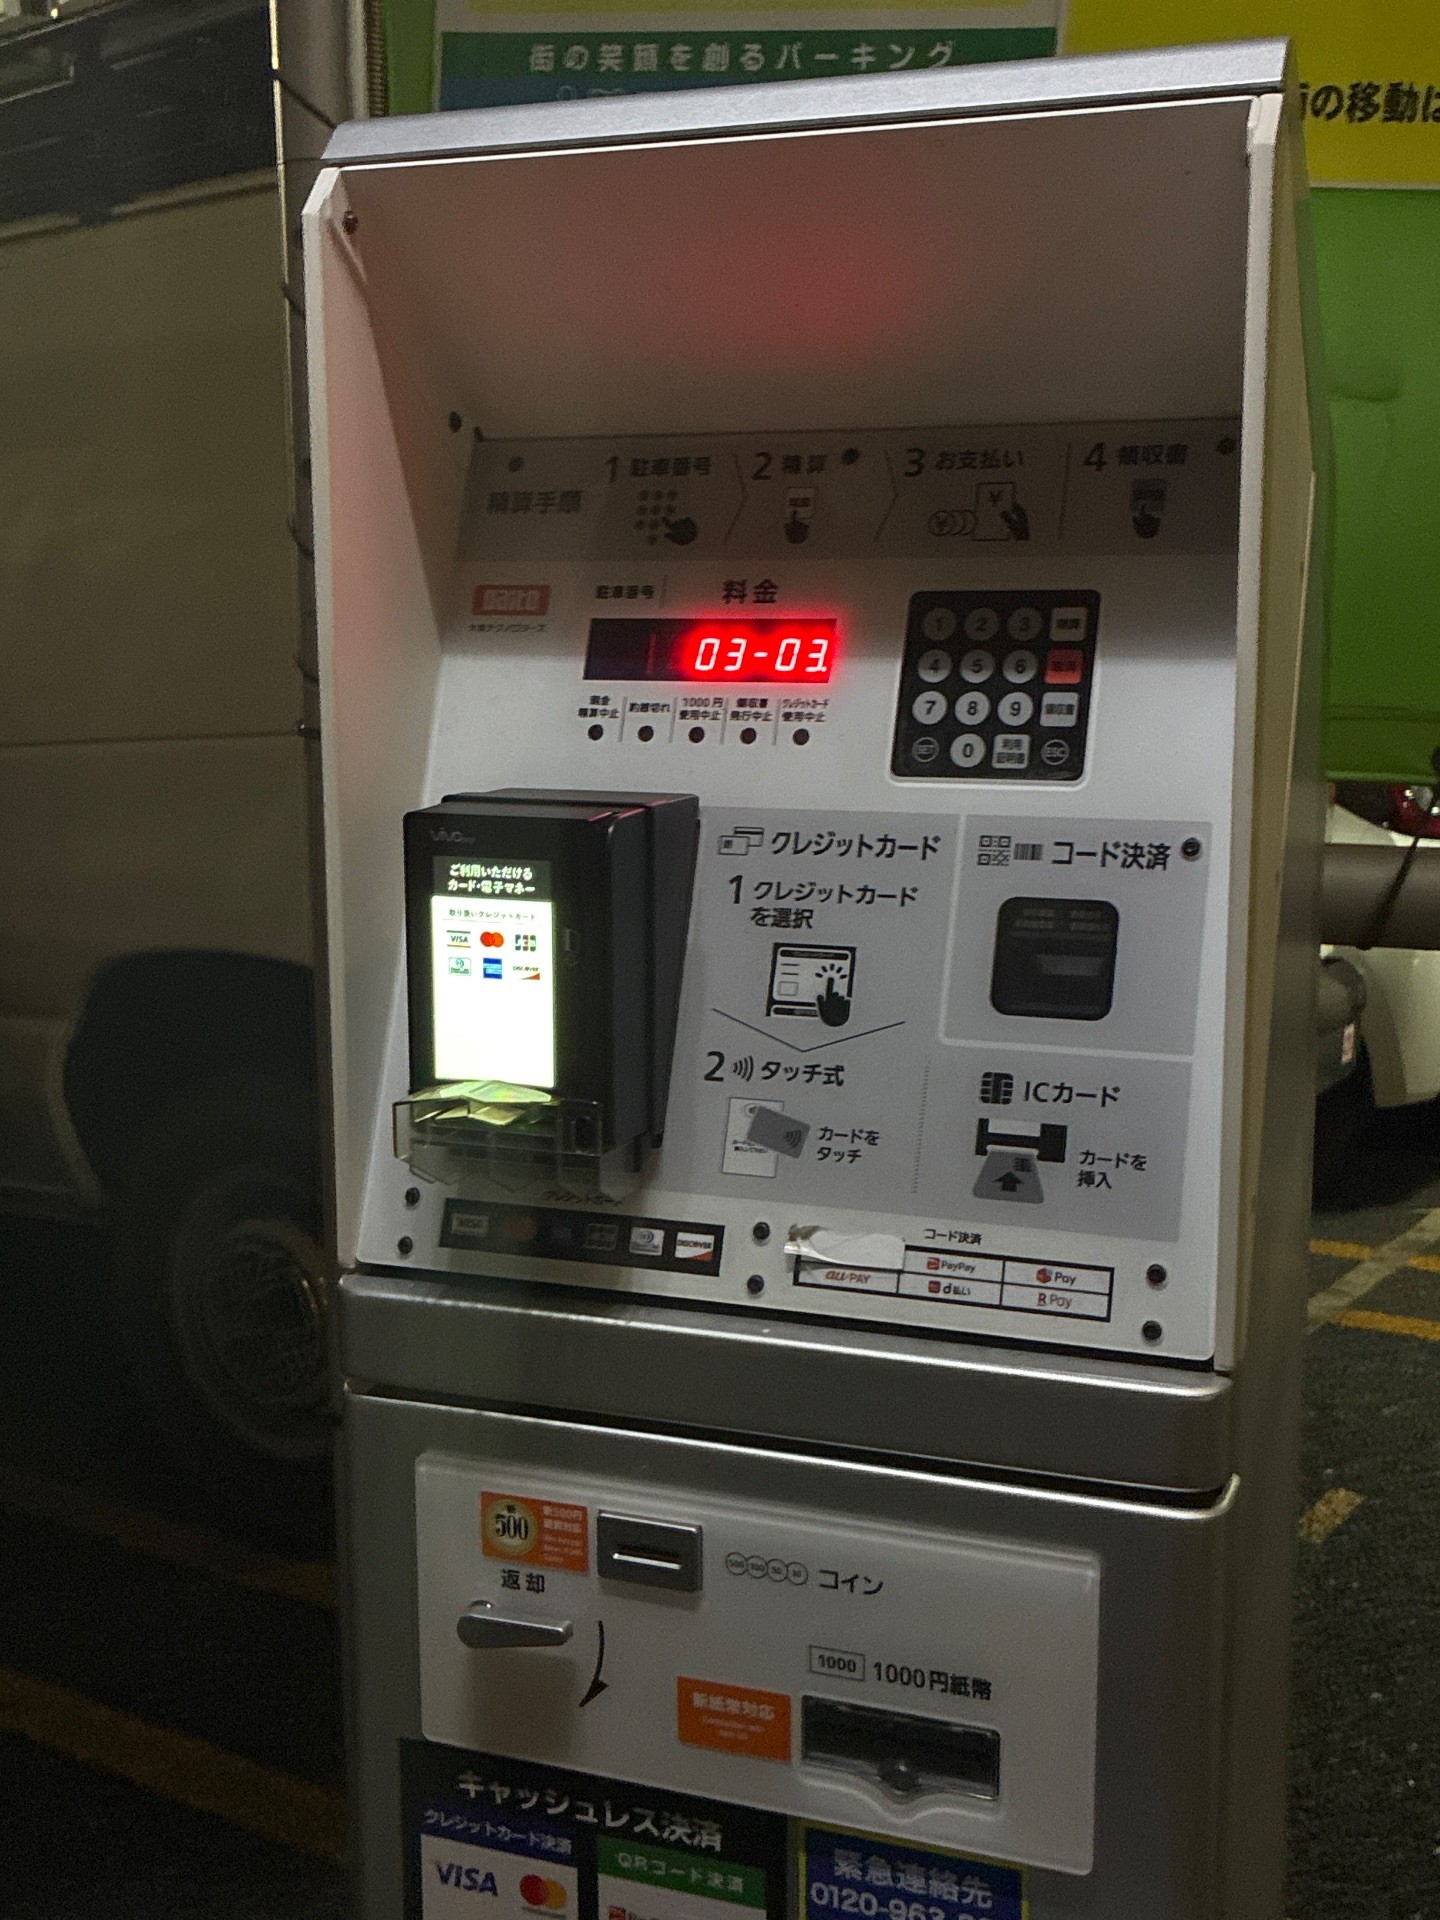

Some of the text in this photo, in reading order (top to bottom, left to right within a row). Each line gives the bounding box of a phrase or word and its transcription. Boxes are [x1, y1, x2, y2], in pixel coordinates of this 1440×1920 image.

[751, 452, 772, 481] 2
[904, 448, 1024, 477] 3 お支払い
[1083, 443, 1188, 472] 4 領収書
[605, 455, 712, 483] 1 駐車番号
[722, 579, 779, 605] 料金
[975, 617, 987, 631] 2
[1020, 617, 1030, 631] 3
[928, 659, 941, 673] 4
[972, 659, 983, 673] 5
[1014, 659, 1025, 673] 6
[923, 701, 936, 715] 7
[967, 701, 978, 715] 8
[1009, 701, 1021, 716] 9
[962, 743, 974, 758] 0
[769, 831, 942, 861] クレジットカード
[1052, 841, 1172, 870] コード決済
[449, 863, 533, 880] ご利用いただける
[447, 879, 536, 895] カード・電子マネー
[727, 875, 919, 907] 1 クレジットカード
[750, 907, 814, 929] を選択
[450, 935, 469, 943] VISA
[703, 1051, 845, 1086] 2 タッチ式
[1023, 1081, 1121, 1107] ICカード
[817, 1126, 880, 1146] カードを
[817, 1147, 863, 1164] タッチ
[1078, 1149, 1147, 1171] カードを
[1077, 1170, 1112, 1190] 挿入
[924, 1228, 983, 1246] コード決済
[941, 1260, 976, 1274] PayPay
[849, 1272, 871, 1285] PAY
[1053, 1271, 1076, 1287] Pay
[1049, 1294, 1073, 1310] Pay
[494, 1514, 529, 1540] 500
[501, 1568, 546, 1594] 返却
[819, 1568, 885, 1596] コイン
[817, 1653, 993, 1701] 1000 1000円紙幣
[457, 1770, 723, 1852] キャッシュレス決済
[424, 1807, 572, 1855] クレジットカード決済
[435, 1860, 499, 1898] VISA
[833, 1848, 993, 1909] 緊急連絡先
